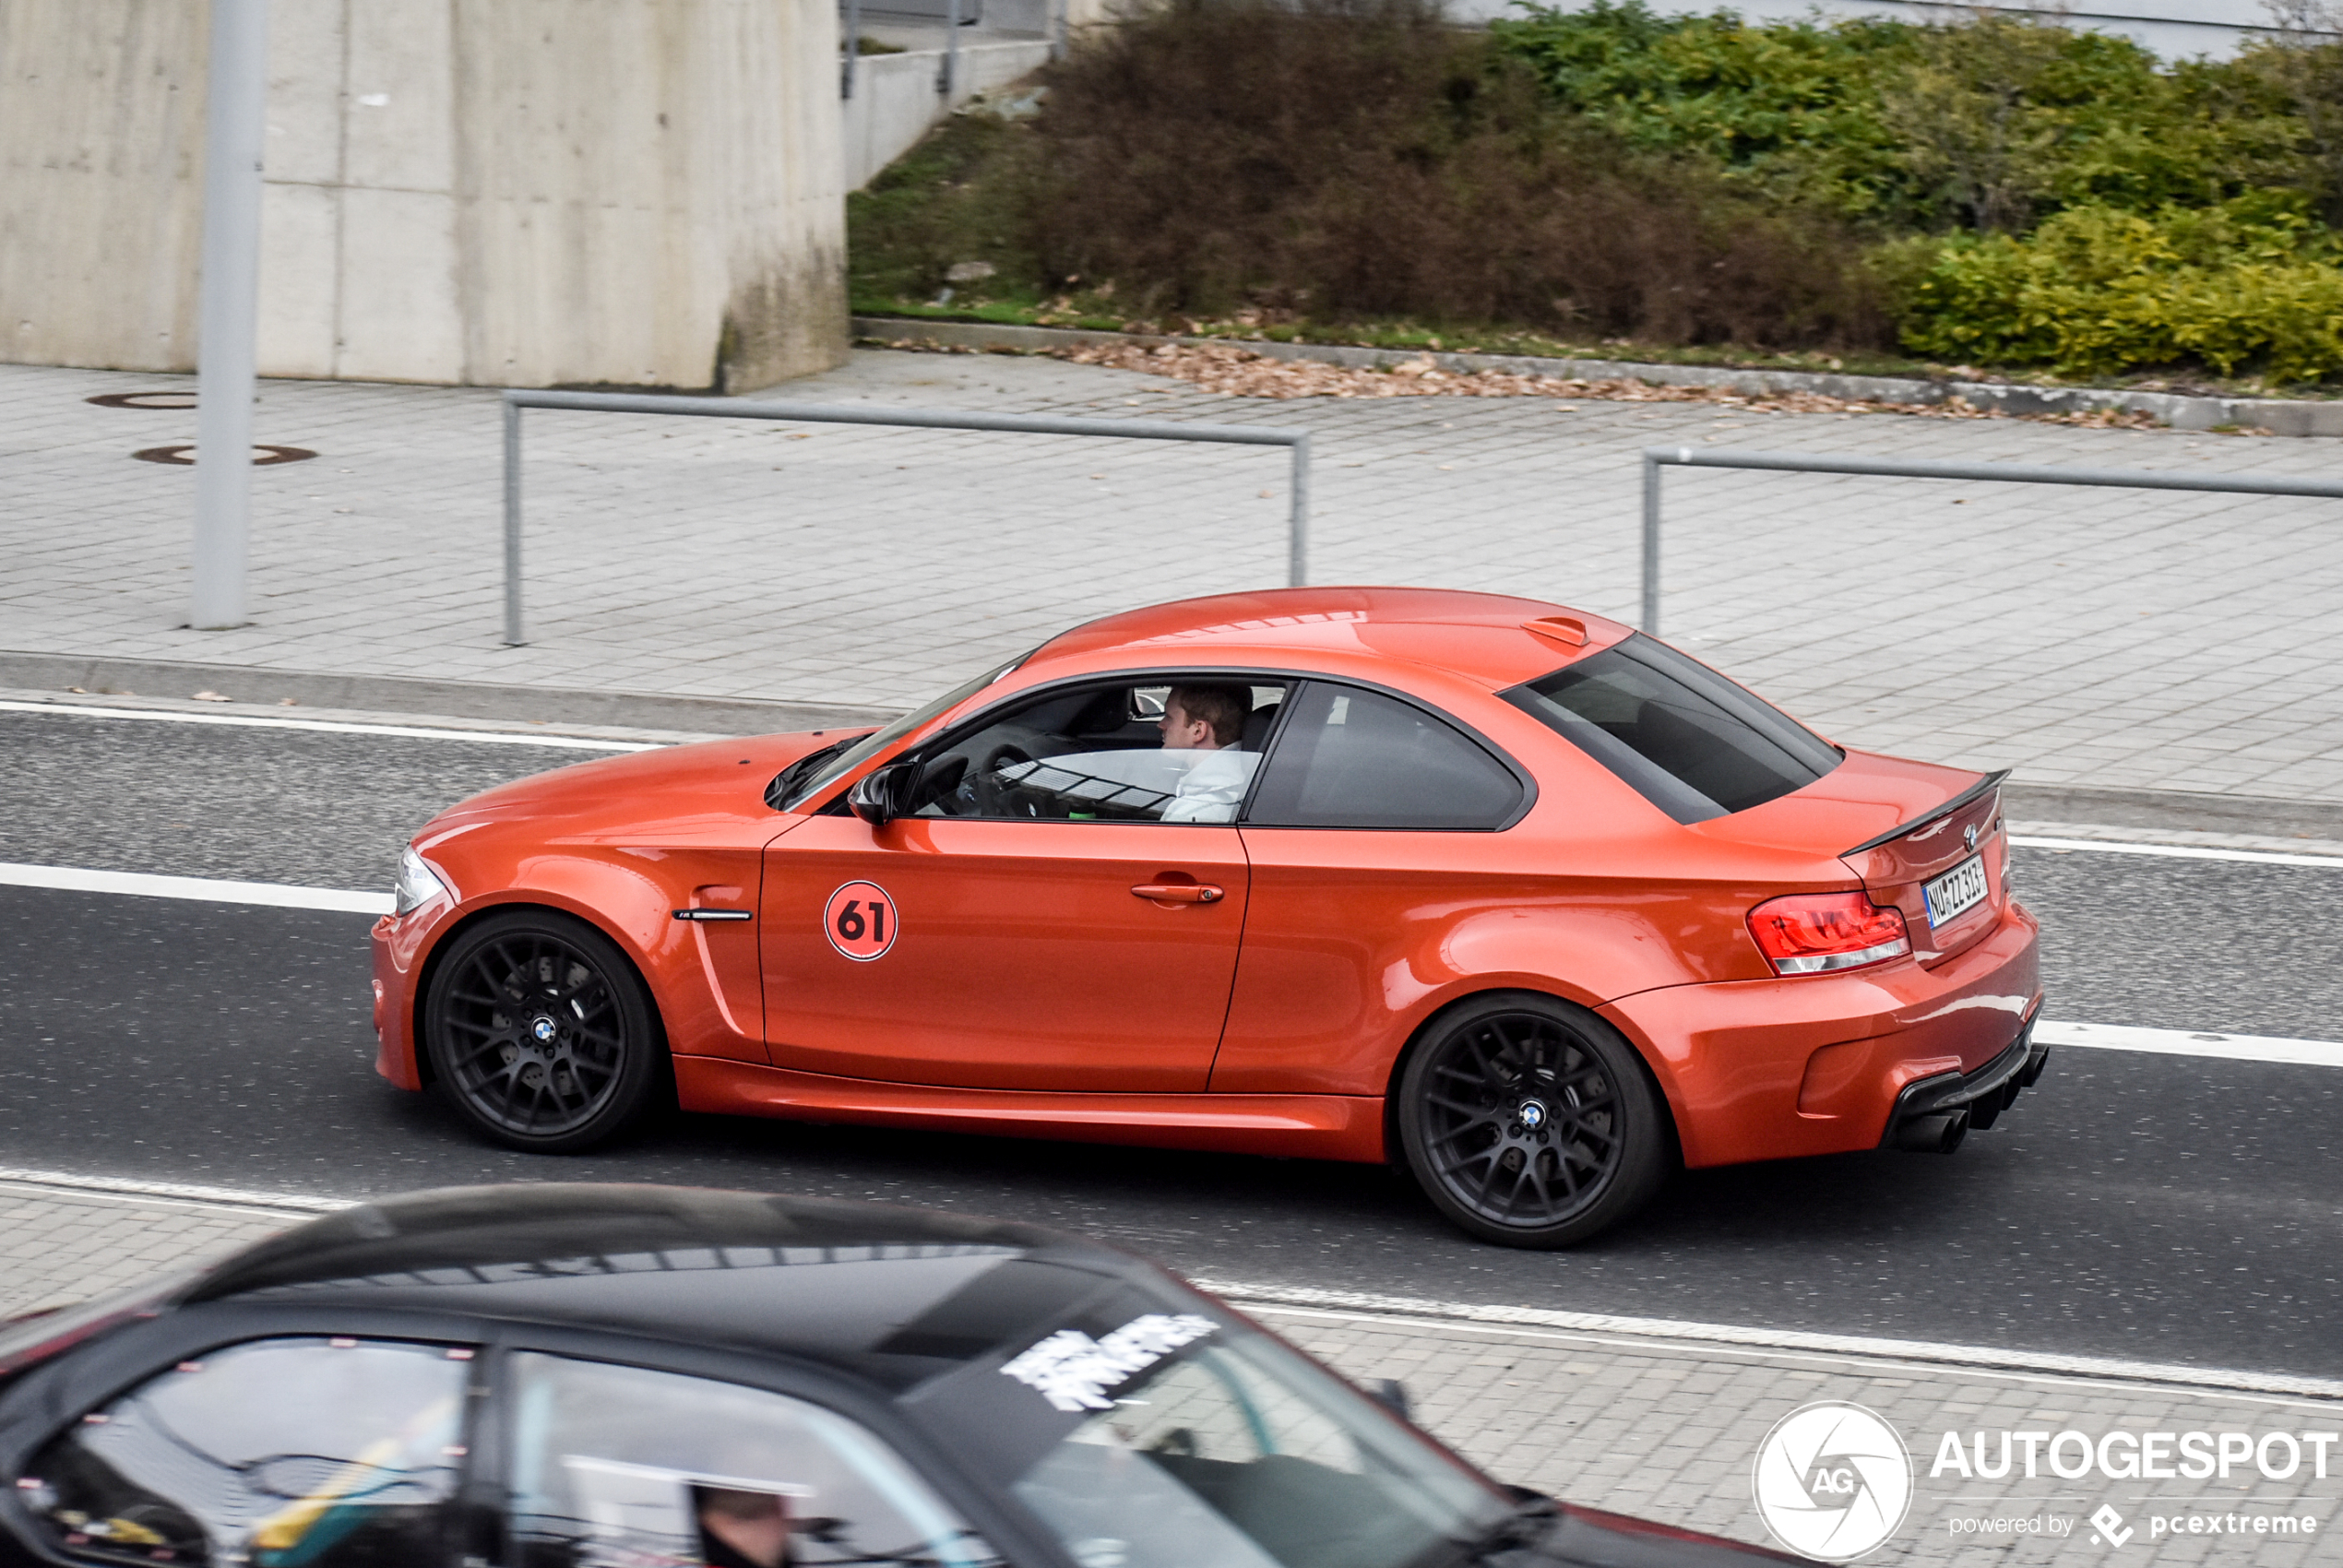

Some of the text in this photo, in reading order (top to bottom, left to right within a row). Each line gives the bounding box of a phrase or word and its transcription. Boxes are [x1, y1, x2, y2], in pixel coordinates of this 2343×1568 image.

[1929, 862, 1980, 921] NU ZZ 313
[837, 899, 885, 943] 61
